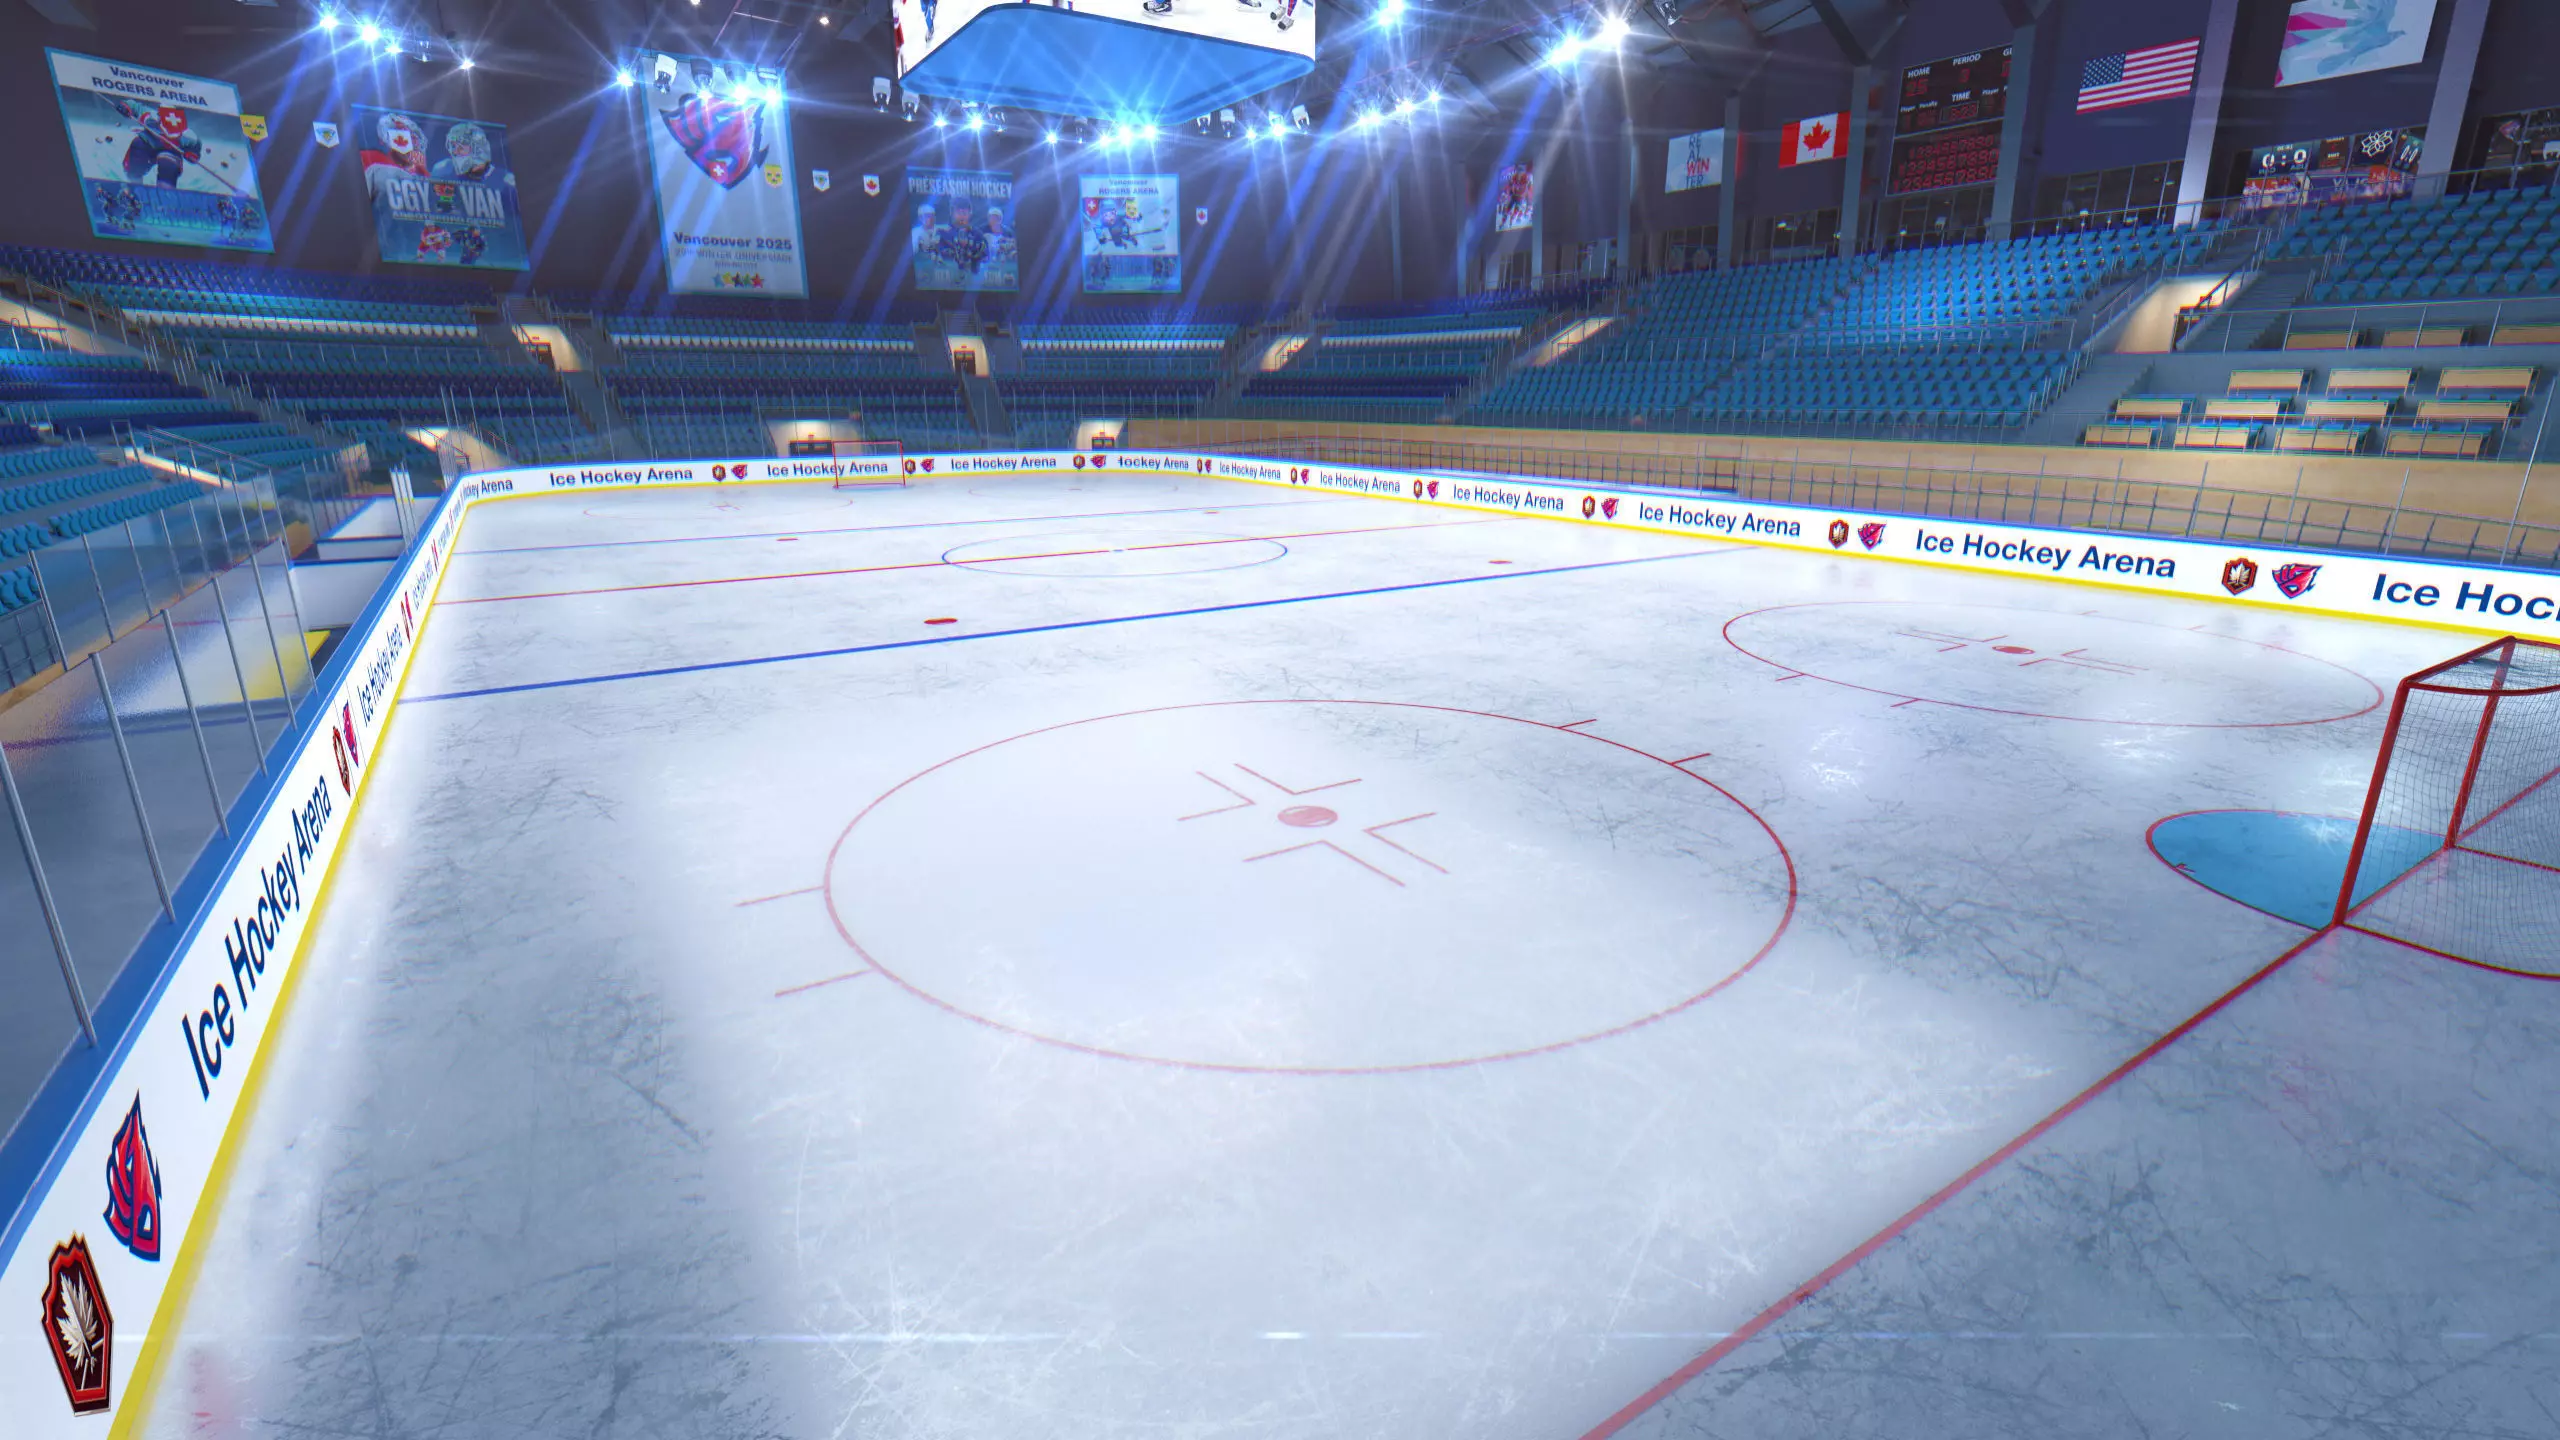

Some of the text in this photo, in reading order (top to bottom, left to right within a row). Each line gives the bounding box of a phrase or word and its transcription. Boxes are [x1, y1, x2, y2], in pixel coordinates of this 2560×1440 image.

[1952, 53, 1981, 67] PERIOD
[109, 65, 185, 89] Vancouver
[1907, 66, 1931, 79] HOME
[91, 76, 208, 107] ROGERS ARENA
[1951, 89, 1971, 102] TIME
[1686, 158, 1710, 177] WIN
[385, 177, 505, 219] CGY VAN
[908, 175, 1012, 199] PRESEASON HOCKEY
[673, 231, 793, 250] Vancouver 2025
[767, 460, 888, 479] Ice Hockey Arena
[950, 456, 1057, 471] Ice Hockey Arena
[1164, 456, 1189, 469] Arena
[1219, 462, 1281, 480] Ice Hockey Arena
[481, 478, 513, 494] Arena
[549, 465, 693, 487] Ice Hockey Arena
[1320, 471, 1401, 493] Ice Hockey Arena
[1453, 484, 1564, 511] Ice Hockey Arena
[1639, 502, 1801, 537] Ice Hockey Arena
[1916, 529, 2177, 578] Ice Hockey Arena
[2372, 573, 2560, 622] Ice Hoc
[357, 683, 374, 728] Ice
[366, 647, 394, 705] Hockey
[181, 774, 333, 1103] Ice Hockey Arena
